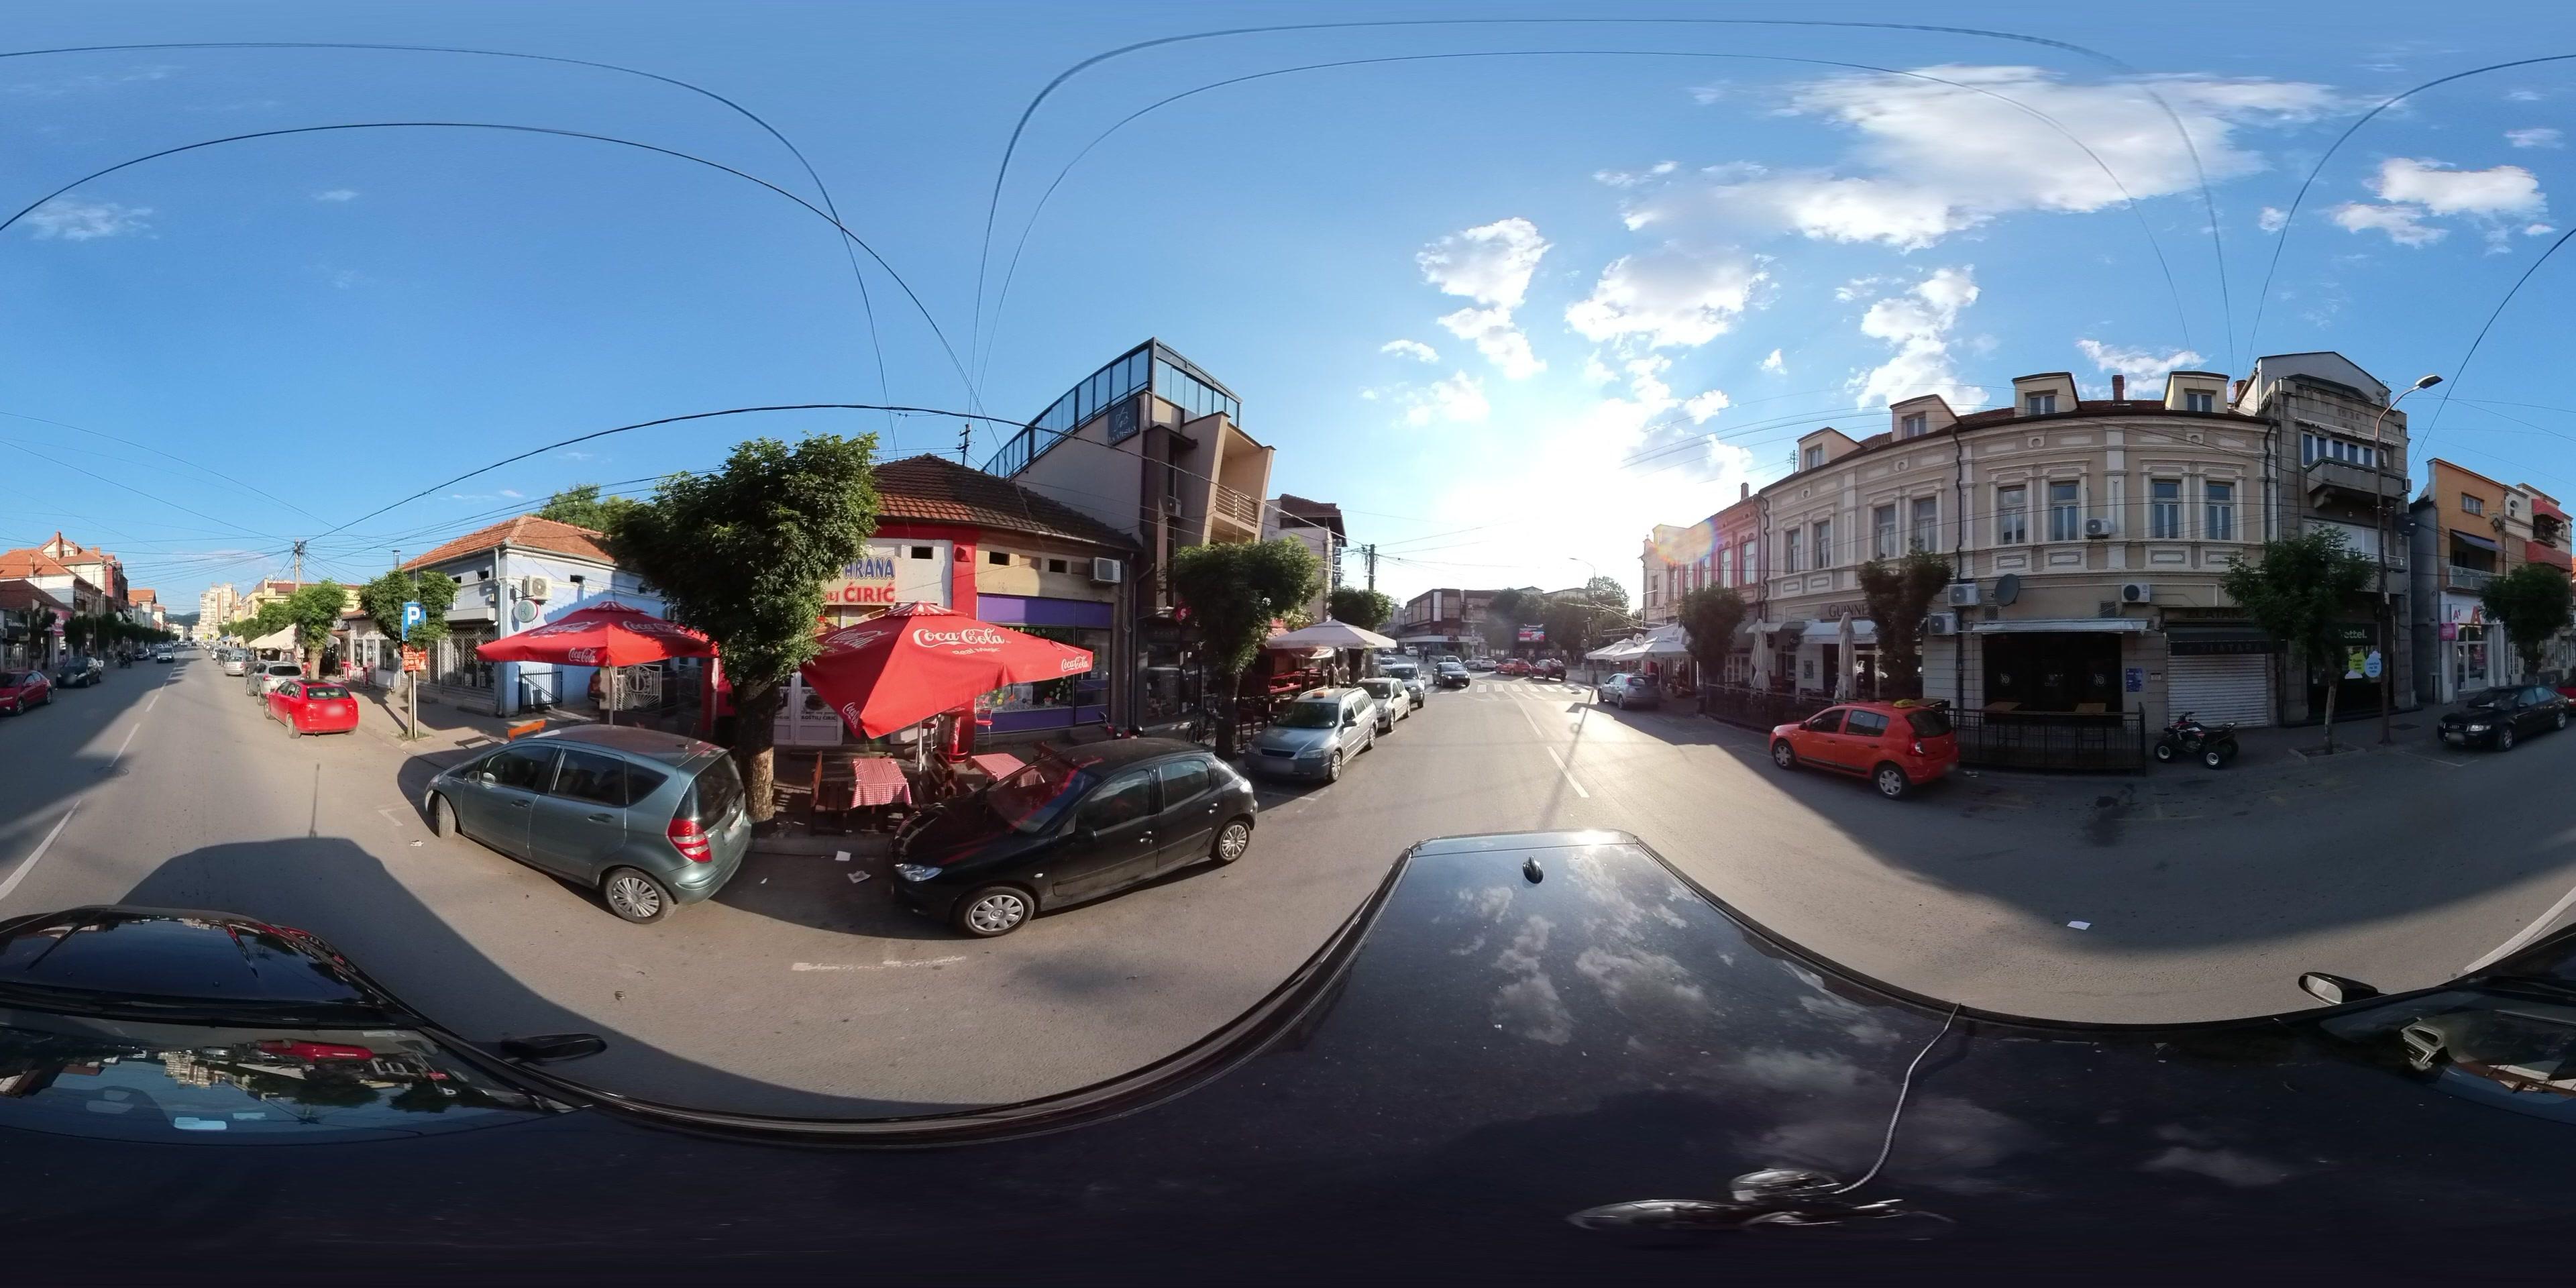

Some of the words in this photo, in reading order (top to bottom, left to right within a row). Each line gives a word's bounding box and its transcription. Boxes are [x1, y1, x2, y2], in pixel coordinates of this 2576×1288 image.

[845, 557, 896, 580] HRANA
[844, 581, 896, 602] ĆIRIĆ
[408, 606, 420, 625] P
[912, 628, 1006, 648] Coca-Cola
[569, 647, 596, 663] Coca-Cola
[1061, 655, 1089, 672] Coca-Cola
